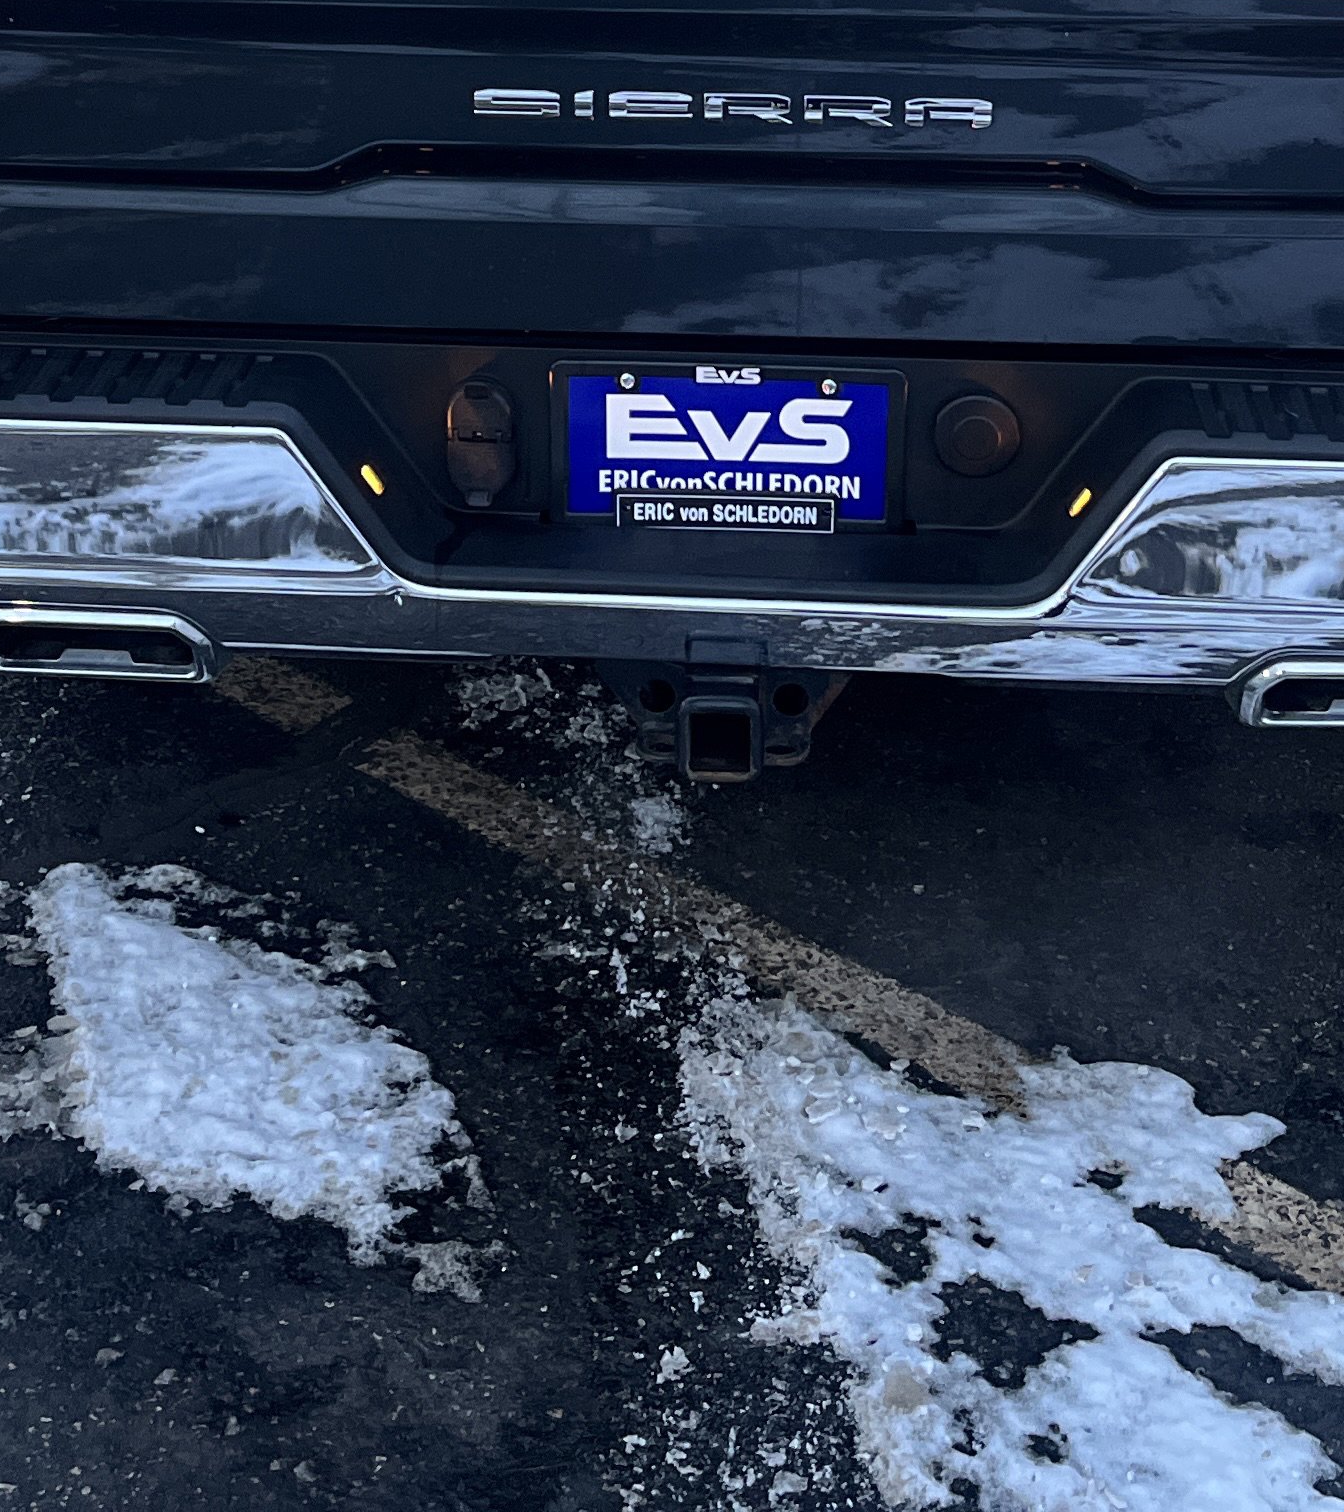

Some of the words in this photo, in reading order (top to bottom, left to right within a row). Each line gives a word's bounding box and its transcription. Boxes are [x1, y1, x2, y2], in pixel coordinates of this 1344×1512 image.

[473, 88, 993, 129] SIERRA
[633, 501, 675, 521] ERIC
[679, 506, 709, 523] von
[712, 503, 818, 526] SCHLEDORN
